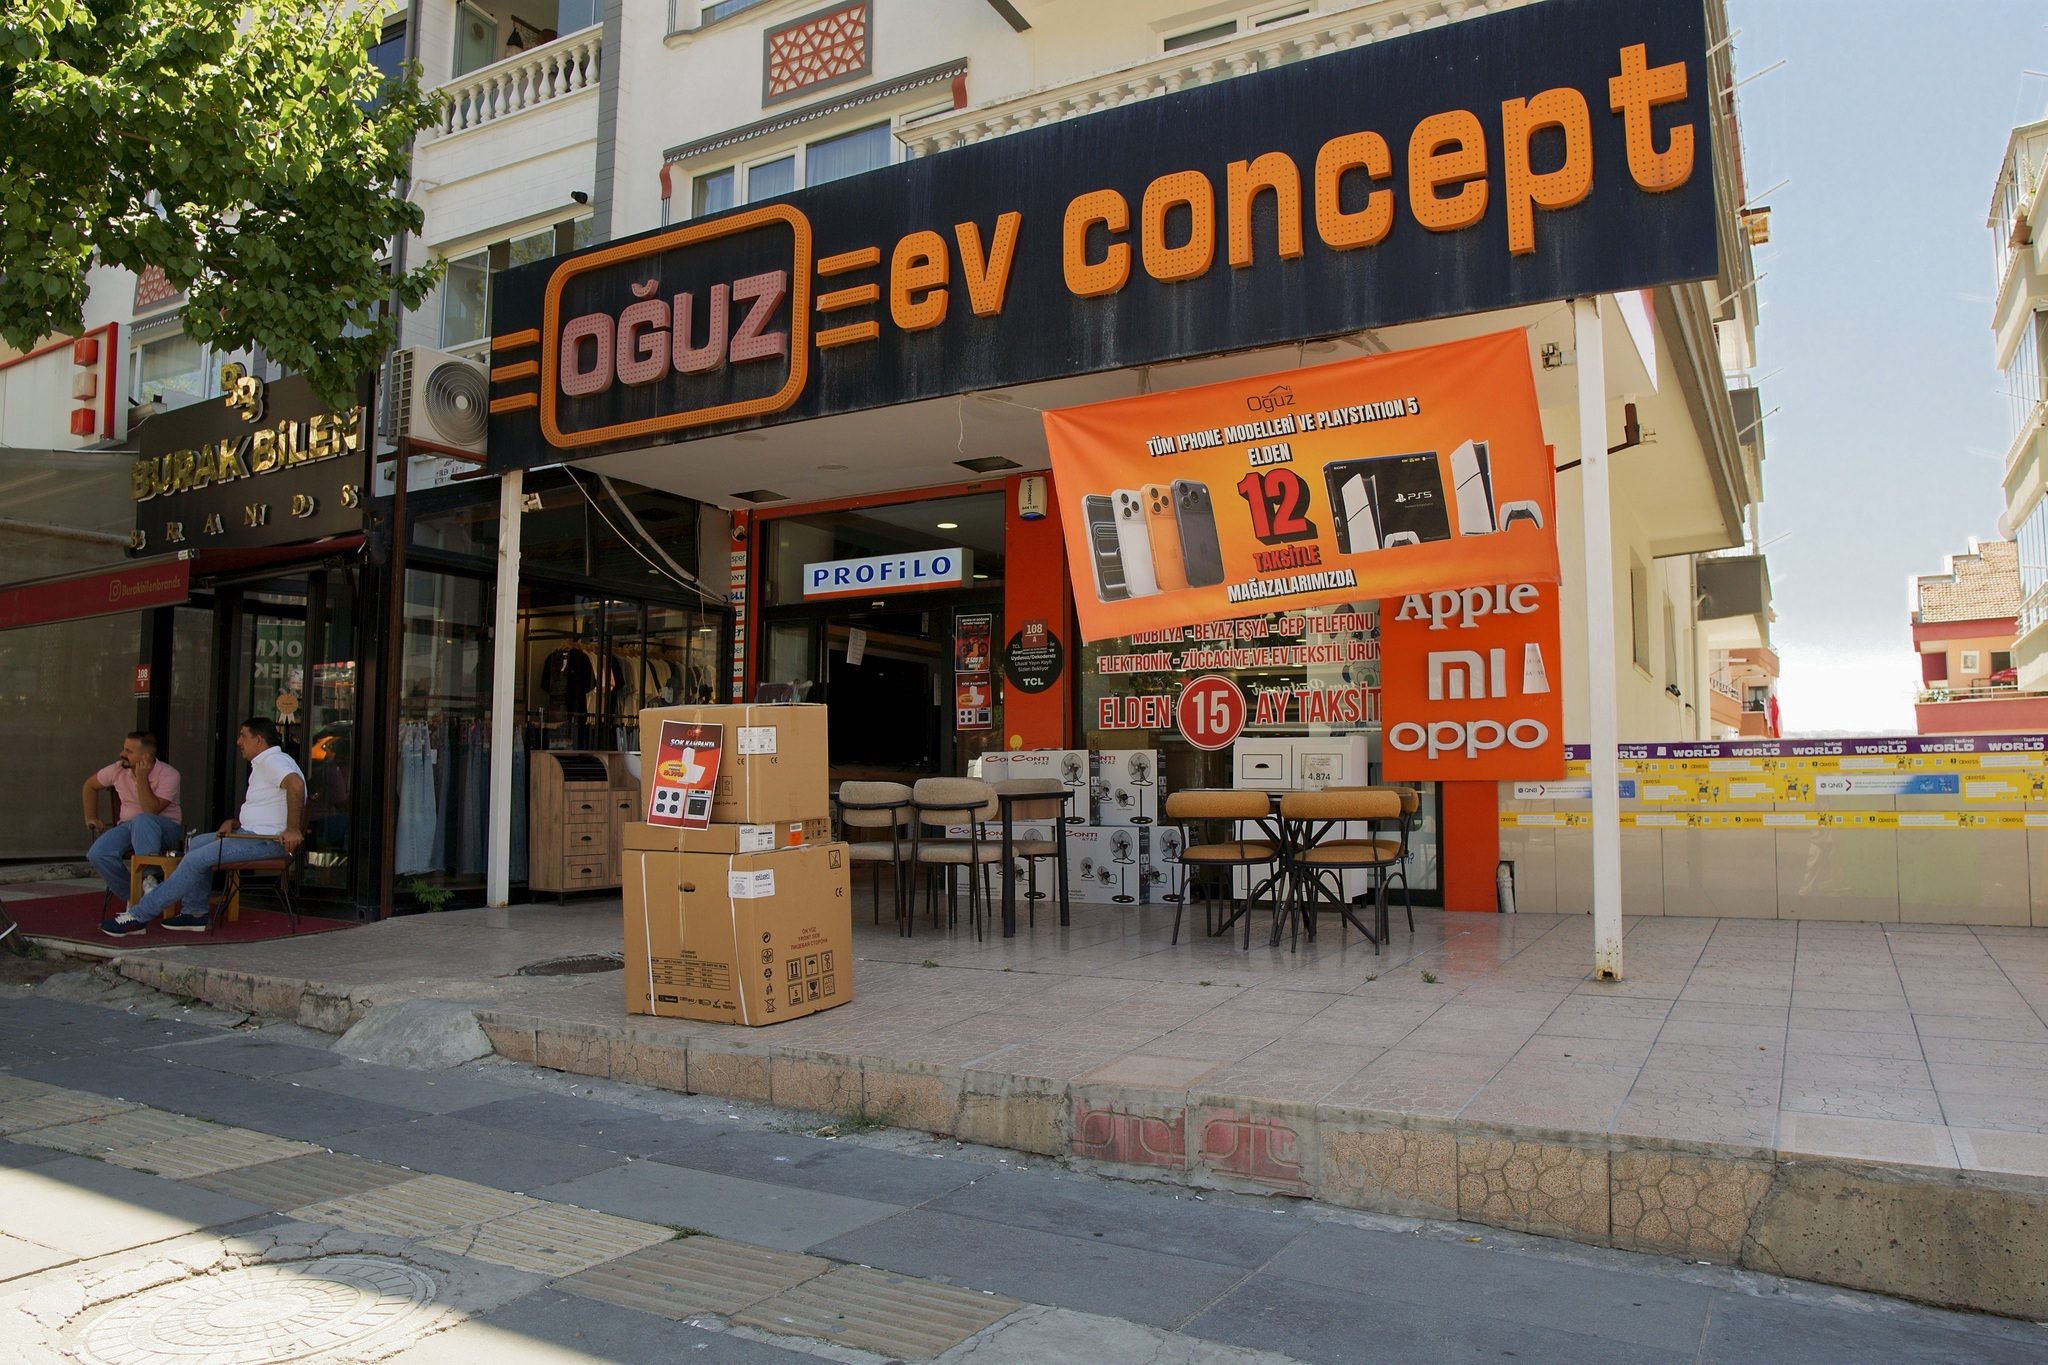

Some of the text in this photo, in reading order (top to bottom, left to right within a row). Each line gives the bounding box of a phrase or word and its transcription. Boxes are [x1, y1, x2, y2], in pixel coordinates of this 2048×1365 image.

[891, 43, 1695, 332] ev concept
[560, 270, 787, 398] OĞUZ
[1247, 392, 1296, 412] Oğuz
[1147, 397, 1420, 457] TÜM IPHONE MODELLERİ VE PLAYSTATION 5
[1248, 443, 1292, 466] ELDEN
[131, 435, 249, 502] BURAK
[1238, 468, 1315, 542] 12
[1408, 491, 1432, 500] PS5
[1253, 544, 1321, 572] TAKSİTLE
[1227, 569, 1357, 603] MAĞAZALARIMIZDA
[1395, 584, 1540, 630] Apple
[1027, 624, 1042, 634] 108
[1194, 620, 1234, 640] BEYAZ
[1236, 618, 1268, 641] EŞYA
[1279, 617, 1305, 637] CEP
[1308, 612, 1375, 634] TELEFONU
[1100, 650, 1172, 674] ELEKTRONİK
[1181, 646, 1250, 669] ZÜCCACİYE
[1252, 647, 1269, 665] VE
[1272, 646, 1290, 665] EV
[1292, 643, 1344, 663] TEKSTİL
[138, 669, 148, 679] 108
[1023, 678, 1044, 686] TCL
[1100, 681, 1381, 734] ELDEN 15 AY TAKSİT
[1389, 718, 1549, 760] oppo
[1855, 745, 1907, 754] WORLD
[1920, 744, 1974, 752] WORLD
[1988, 743, 2045, 751] WORLD
[1012, 754, 1049, 762] CONTI
[1619, 751, 1648, 759] RLD
[1673, 749, 1720, 757] WORLD
[1732, 748, 1780, 756] WORLD
[1792, 747, 1842, 755] WORLD
